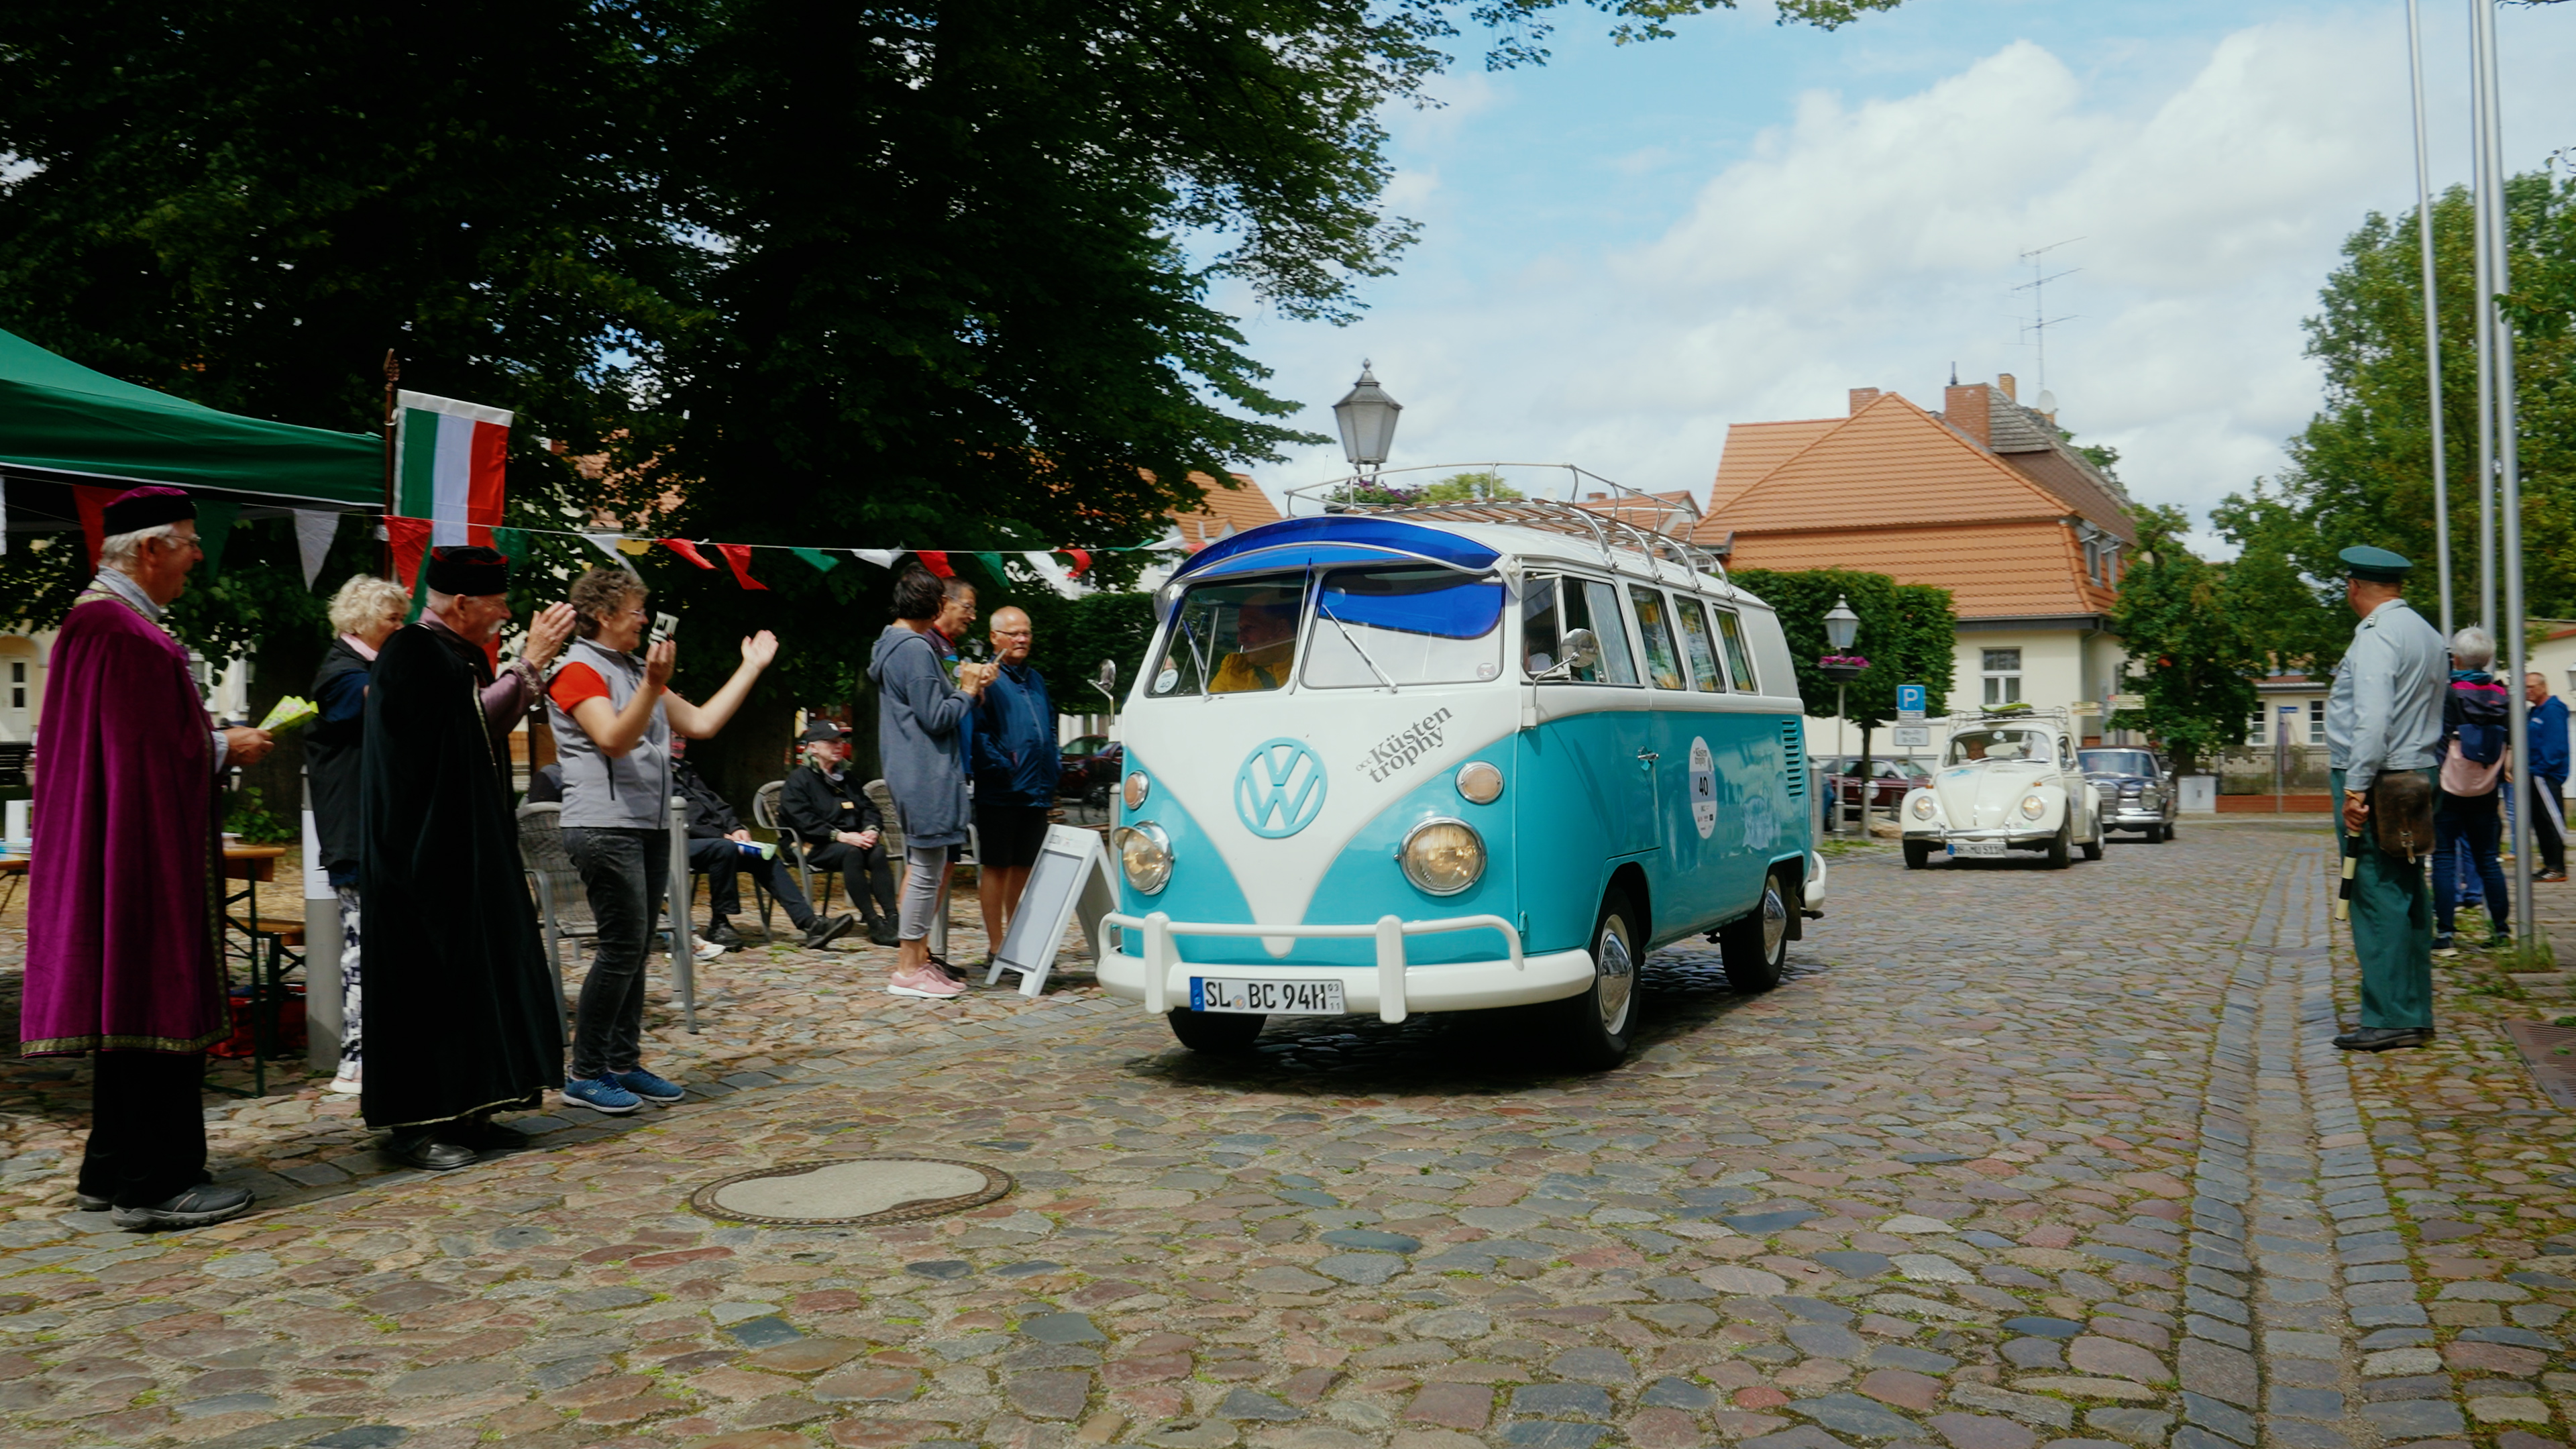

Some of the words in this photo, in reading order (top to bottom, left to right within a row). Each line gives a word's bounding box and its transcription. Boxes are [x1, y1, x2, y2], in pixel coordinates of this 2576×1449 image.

[1904, 689, 1918, 707] P
[1368, 707, 1453, 765] Küsten
[1369, 727, 1444, 783] trophy
[1699, 776, 1709, 796] 40
[1205, 981, 1232, 1007] SL
[1248, 983, 1276, 1009] BC
[1283, 984, 1326, 1010] 94H
